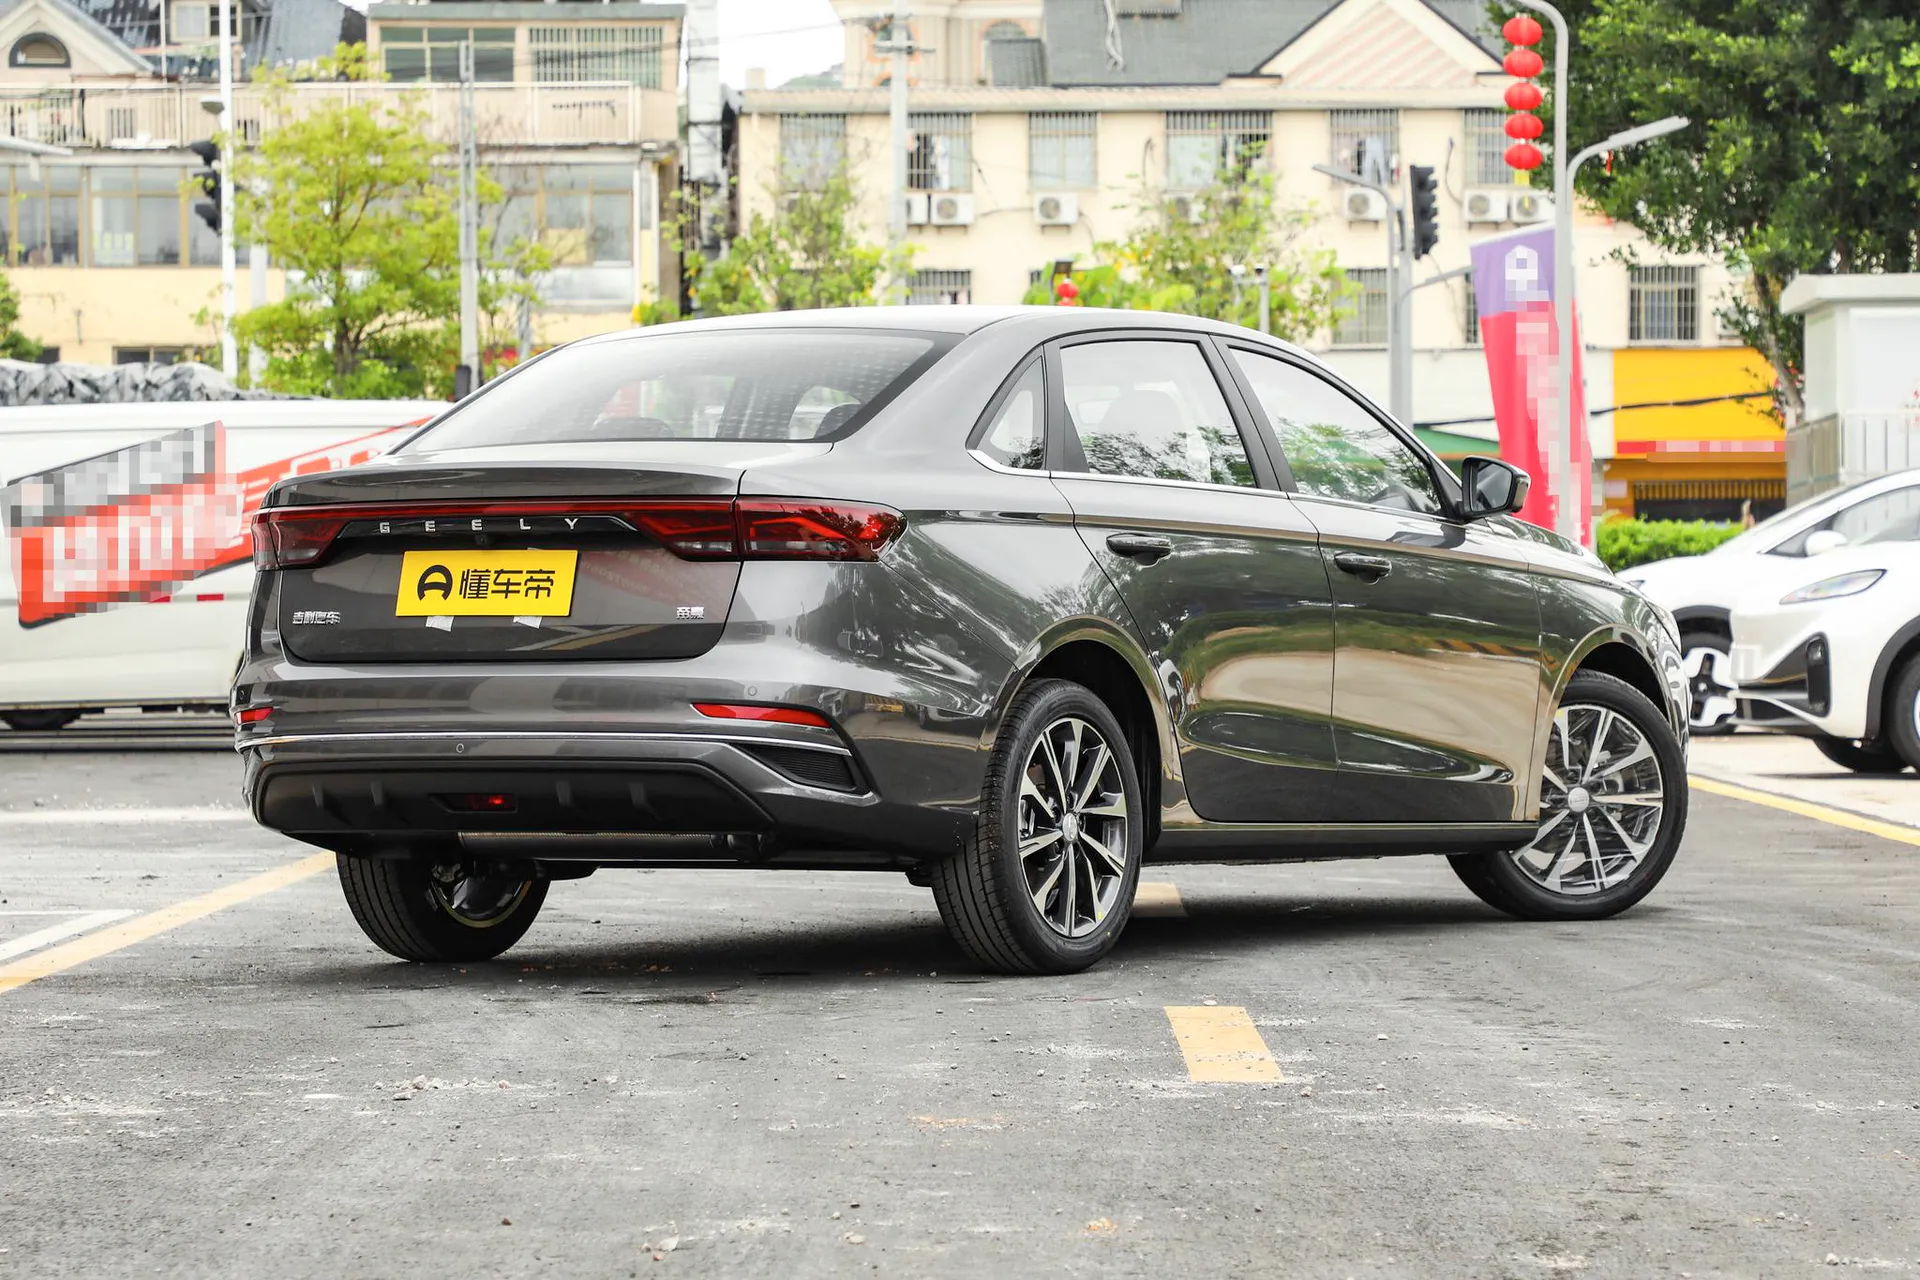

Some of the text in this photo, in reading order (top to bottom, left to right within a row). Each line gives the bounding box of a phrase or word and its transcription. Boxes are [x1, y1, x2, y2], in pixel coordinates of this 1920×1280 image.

[379, 518, 579, 534] GEELY
[459, 568, 556, 600] 懂车帝
